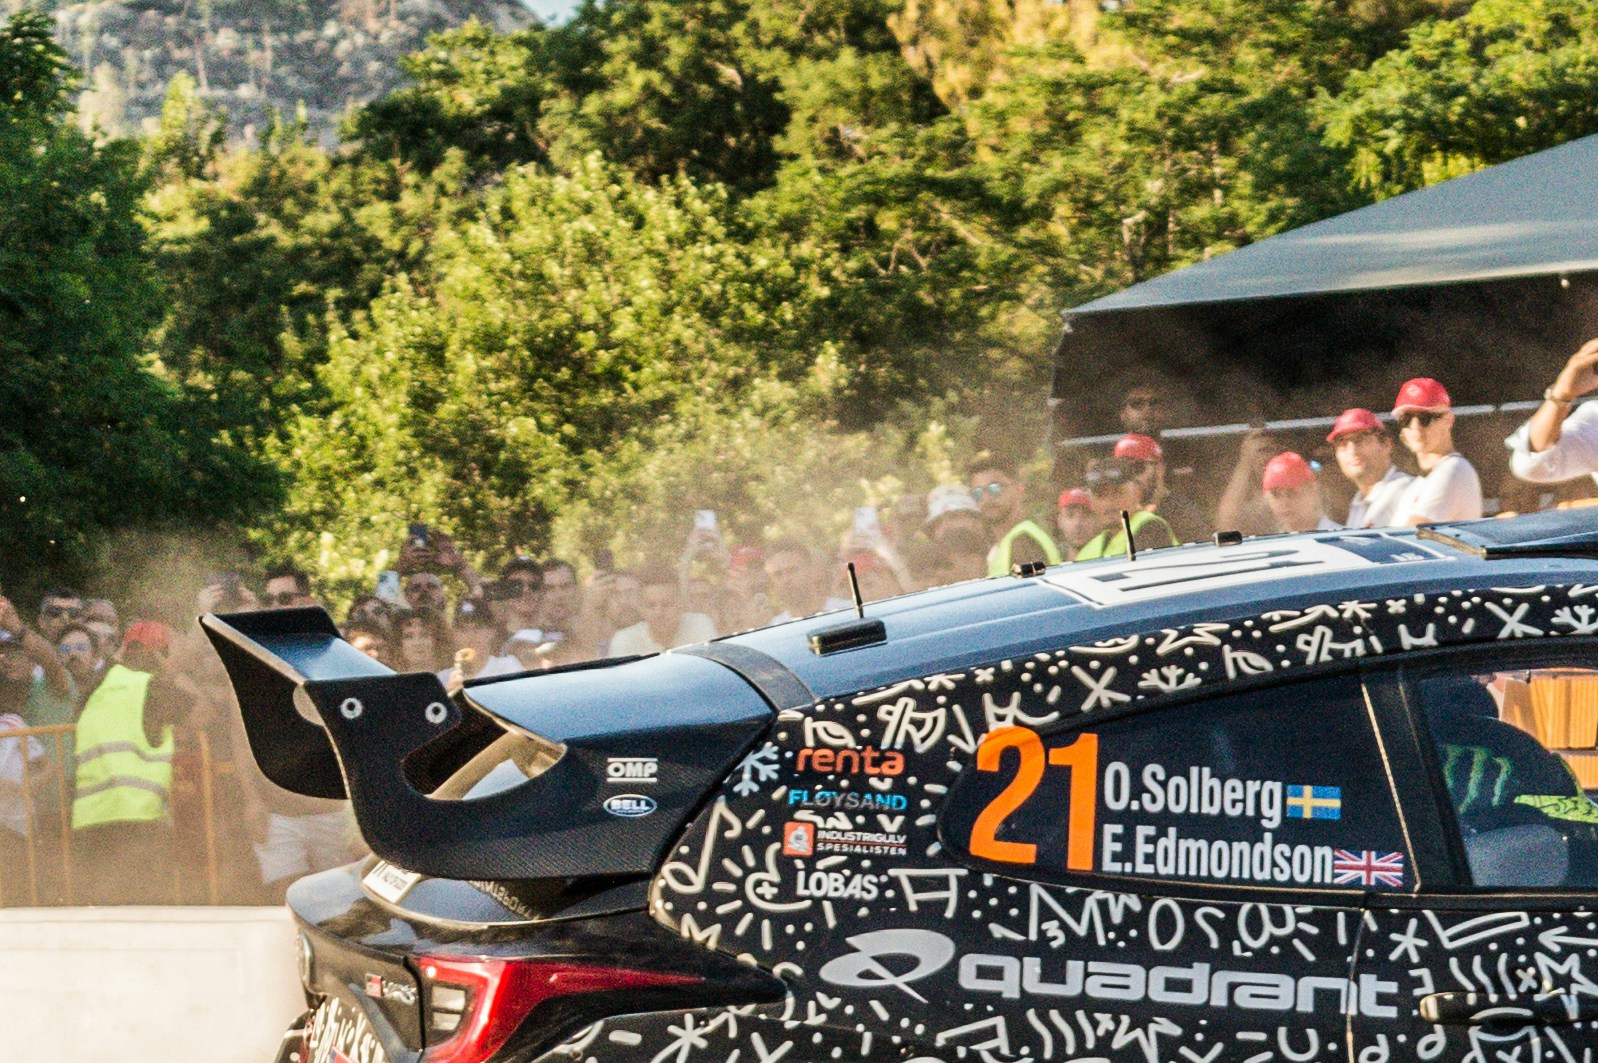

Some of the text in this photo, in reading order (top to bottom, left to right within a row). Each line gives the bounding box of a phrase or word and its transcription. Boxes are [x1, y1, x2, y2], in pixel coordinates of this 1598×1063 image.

[607, 762, 658, 778] OMP
[796, 747, 905, 776] renta
[610, 799, 652, 811] BELL
[788, 789, 908, 811] FLØYSAND
[969, 724, 1099, 871] 21
[1104, 760, 1283, 830] O.Solberg
[816, 842, 907, 856] SPESIALISTEN
[817, 830, 907, 844] INDUSTRIGULV
[1103, 827, 1334, 883] E.Edmondson
[796, 871, 879, 901] LOBAS
[957, 953, 1399, 1018] quadrant
